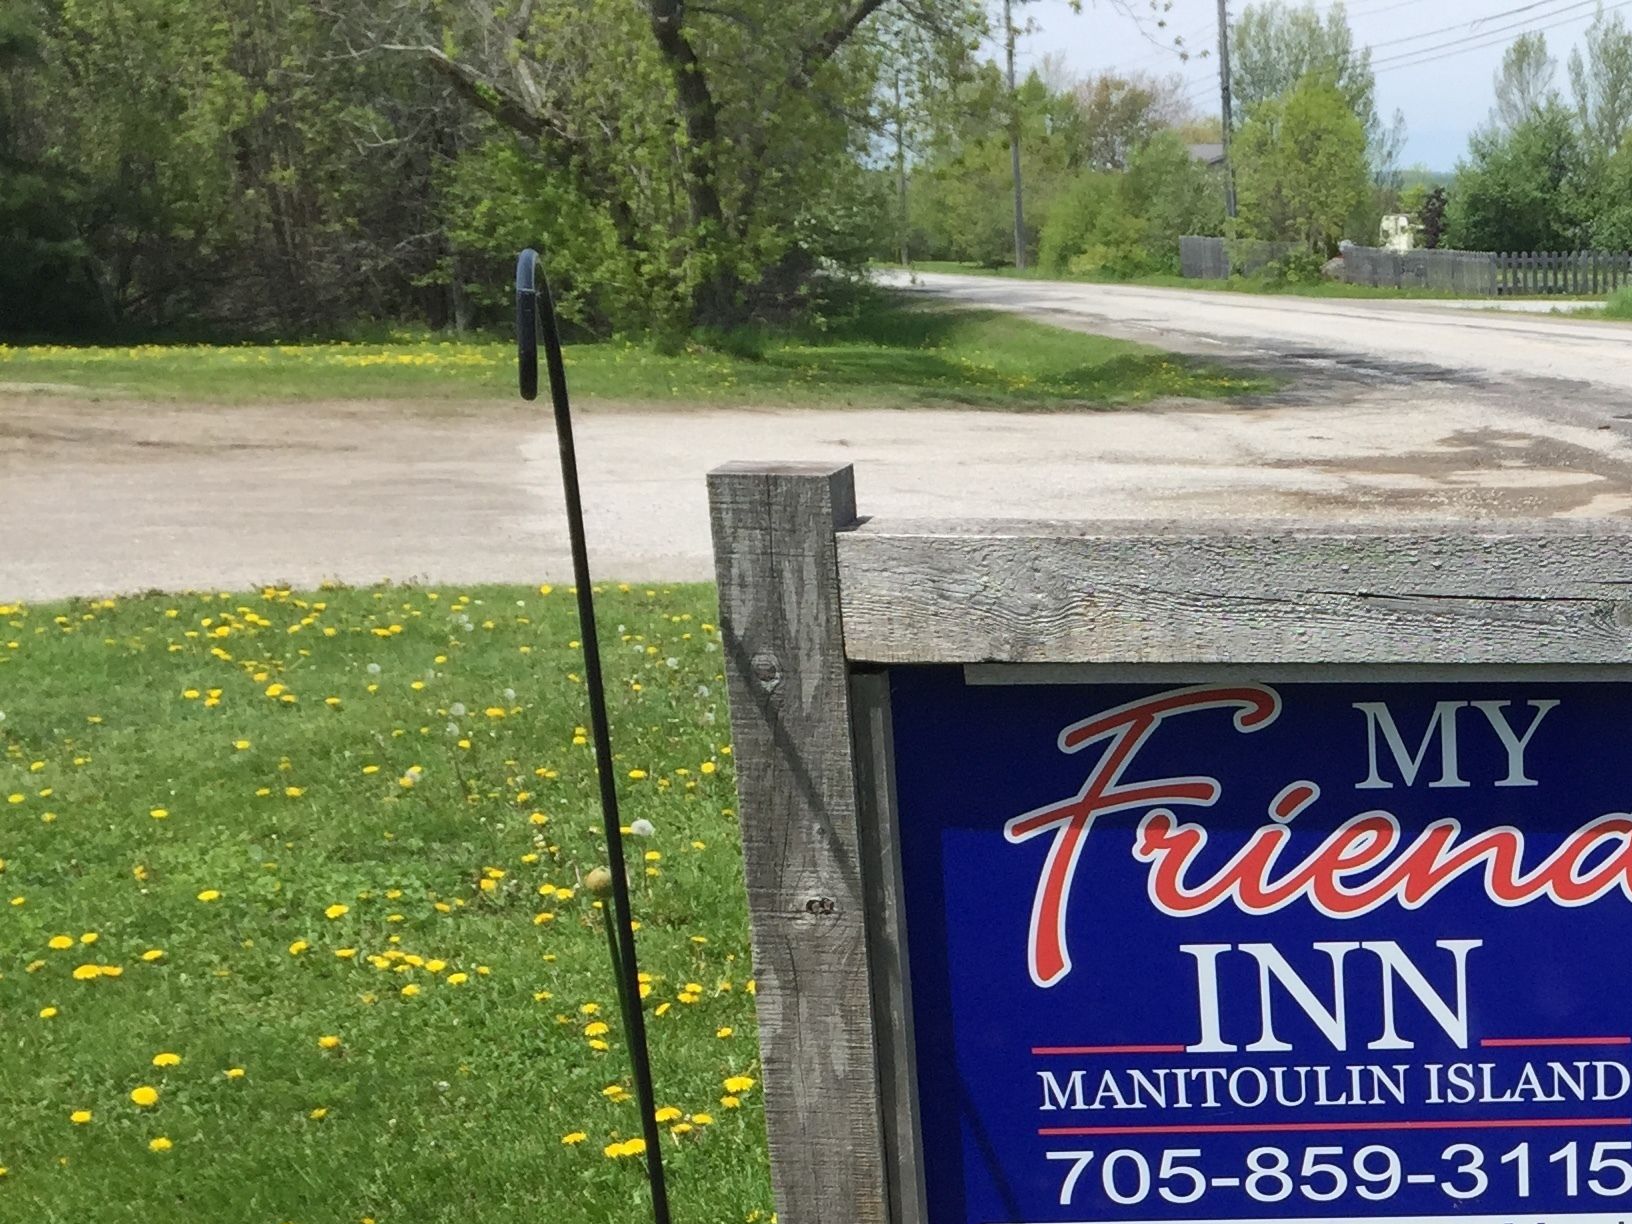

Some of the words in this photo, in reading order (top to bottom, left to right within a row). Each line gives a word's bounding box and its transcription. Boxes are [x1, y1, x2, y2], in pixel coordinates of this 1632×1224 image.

[1353, 699, 1560, 790] MY
[1179, 939, 1483, 1053] INN
[1037, 1064, 1408, 1111] MANITOULIN
[1423, 1061, 1631, 1104] ISLAND
